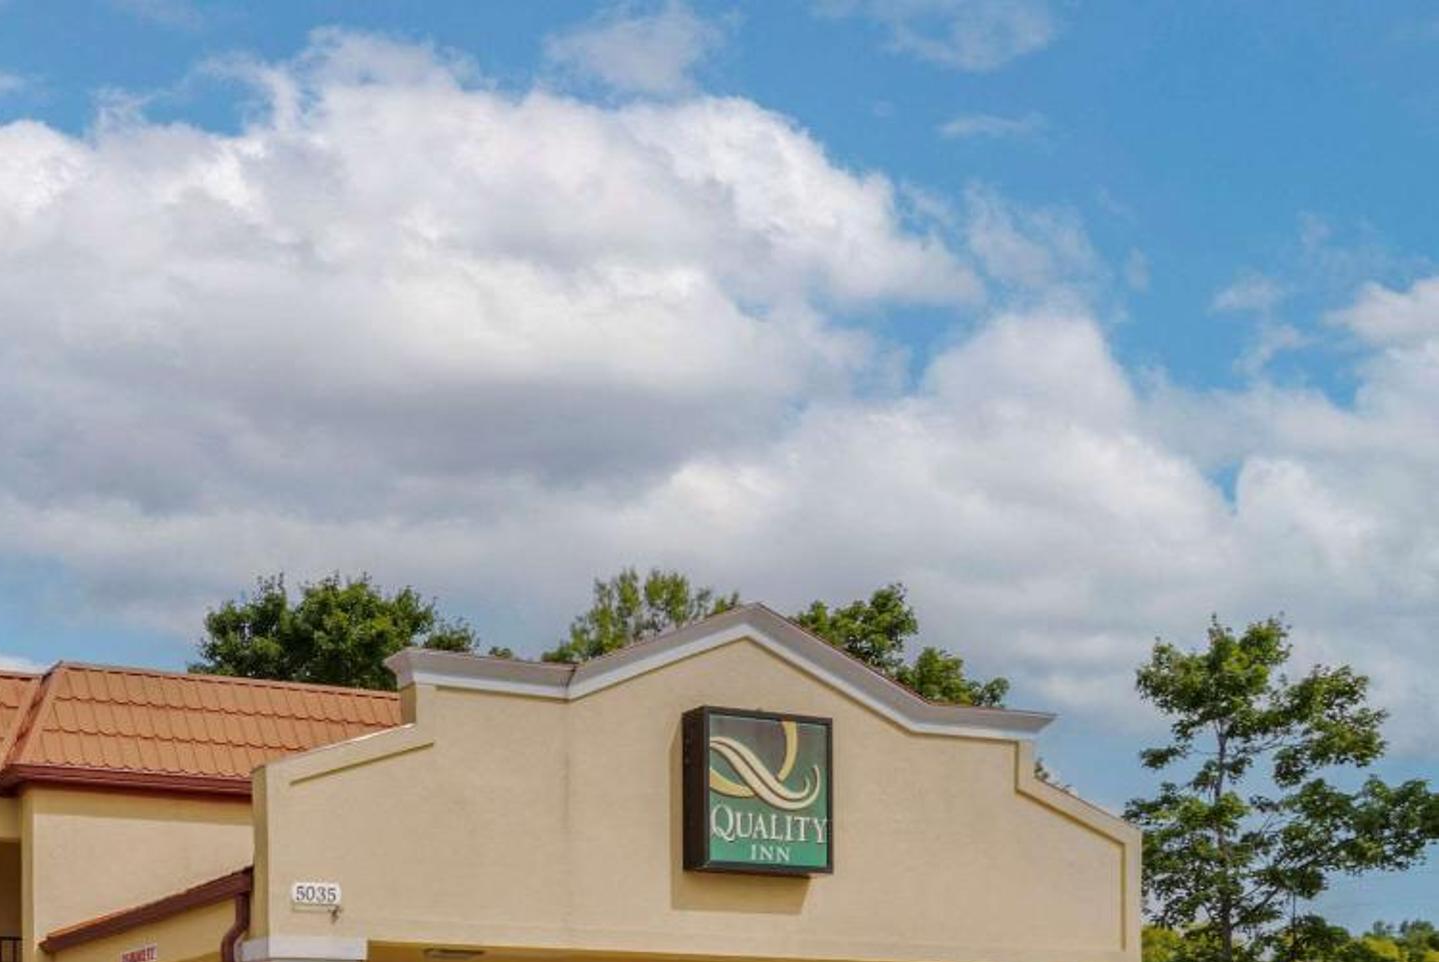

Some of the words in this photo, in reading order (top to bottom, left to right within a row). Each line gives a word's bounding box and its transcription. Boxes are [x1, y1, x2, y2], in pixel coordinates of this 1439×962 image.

[710, 804, 827, 843] QUALITY
[751, 844, 790, 861] INN
[296, 885, 336, 902] 5035
